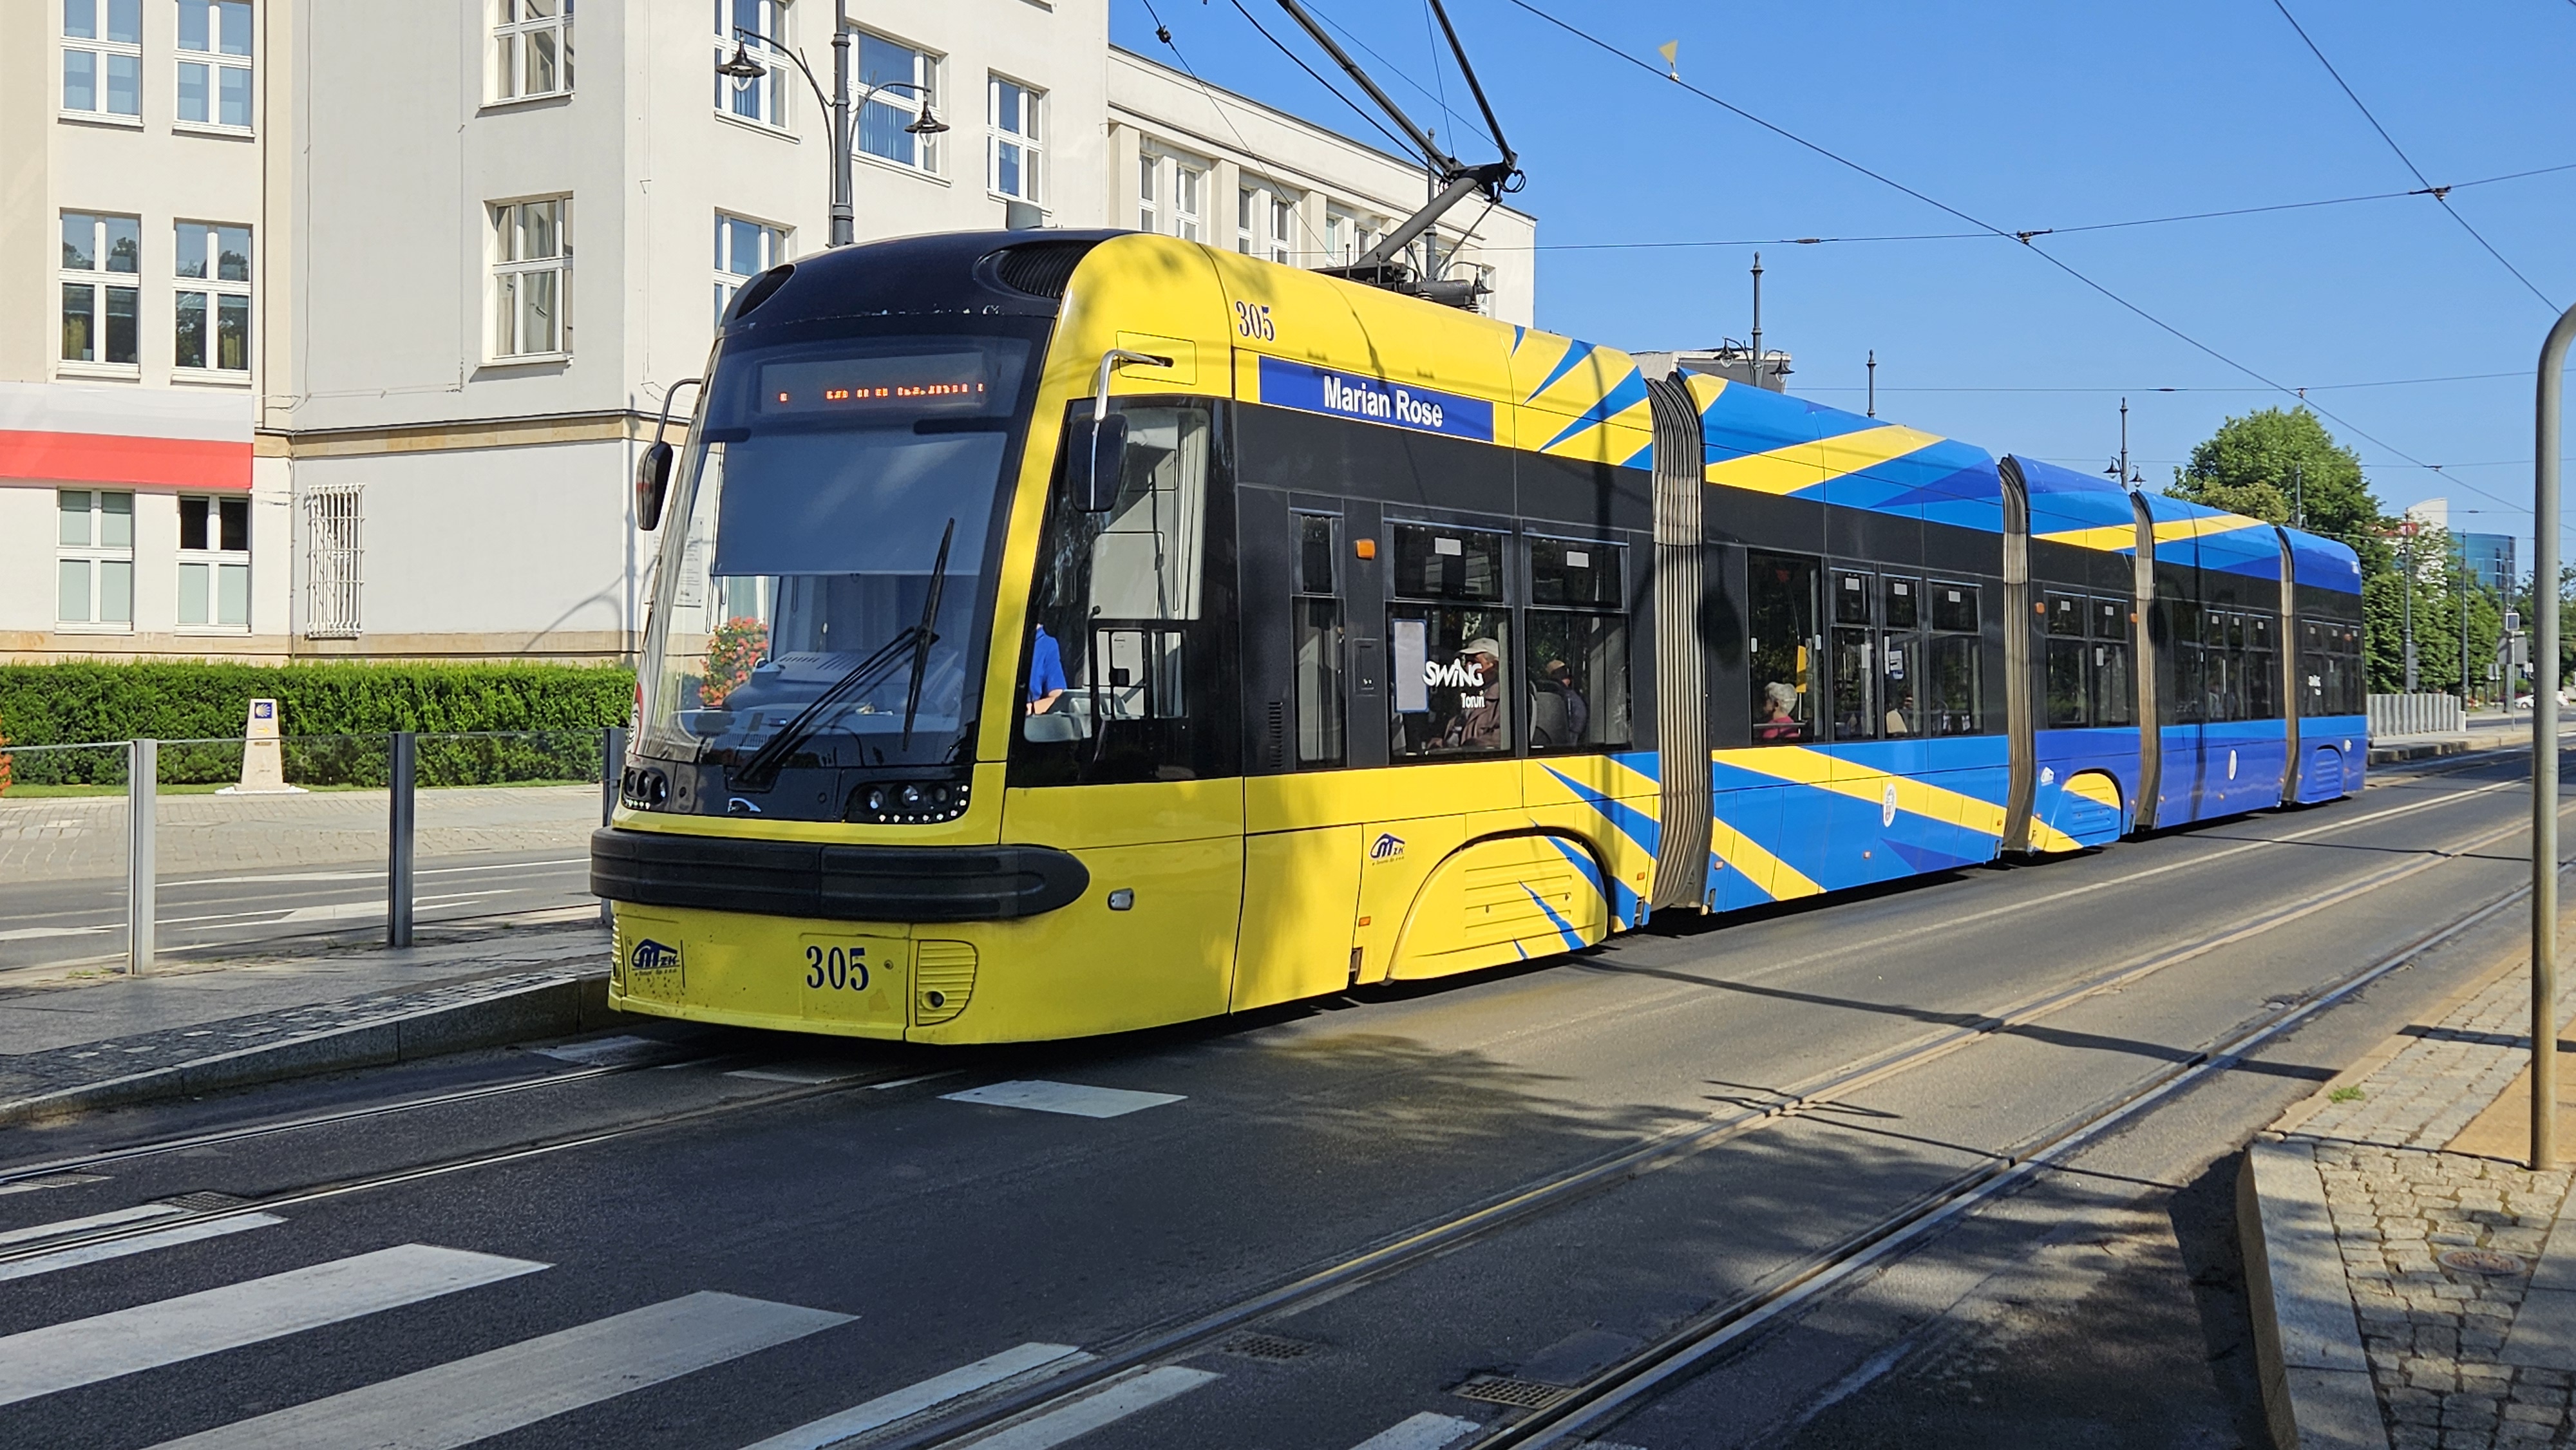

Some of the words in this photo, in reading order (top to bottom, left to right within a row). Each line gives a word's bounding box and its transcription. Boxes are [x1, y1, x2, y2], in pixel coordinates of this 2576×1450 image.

[1236, 301, 1274, 341] 305
[1324, 375, 1390, 419] Marian
[1396, 389, 1443, 428] Rose
[806, 946, 869, 991] 305
